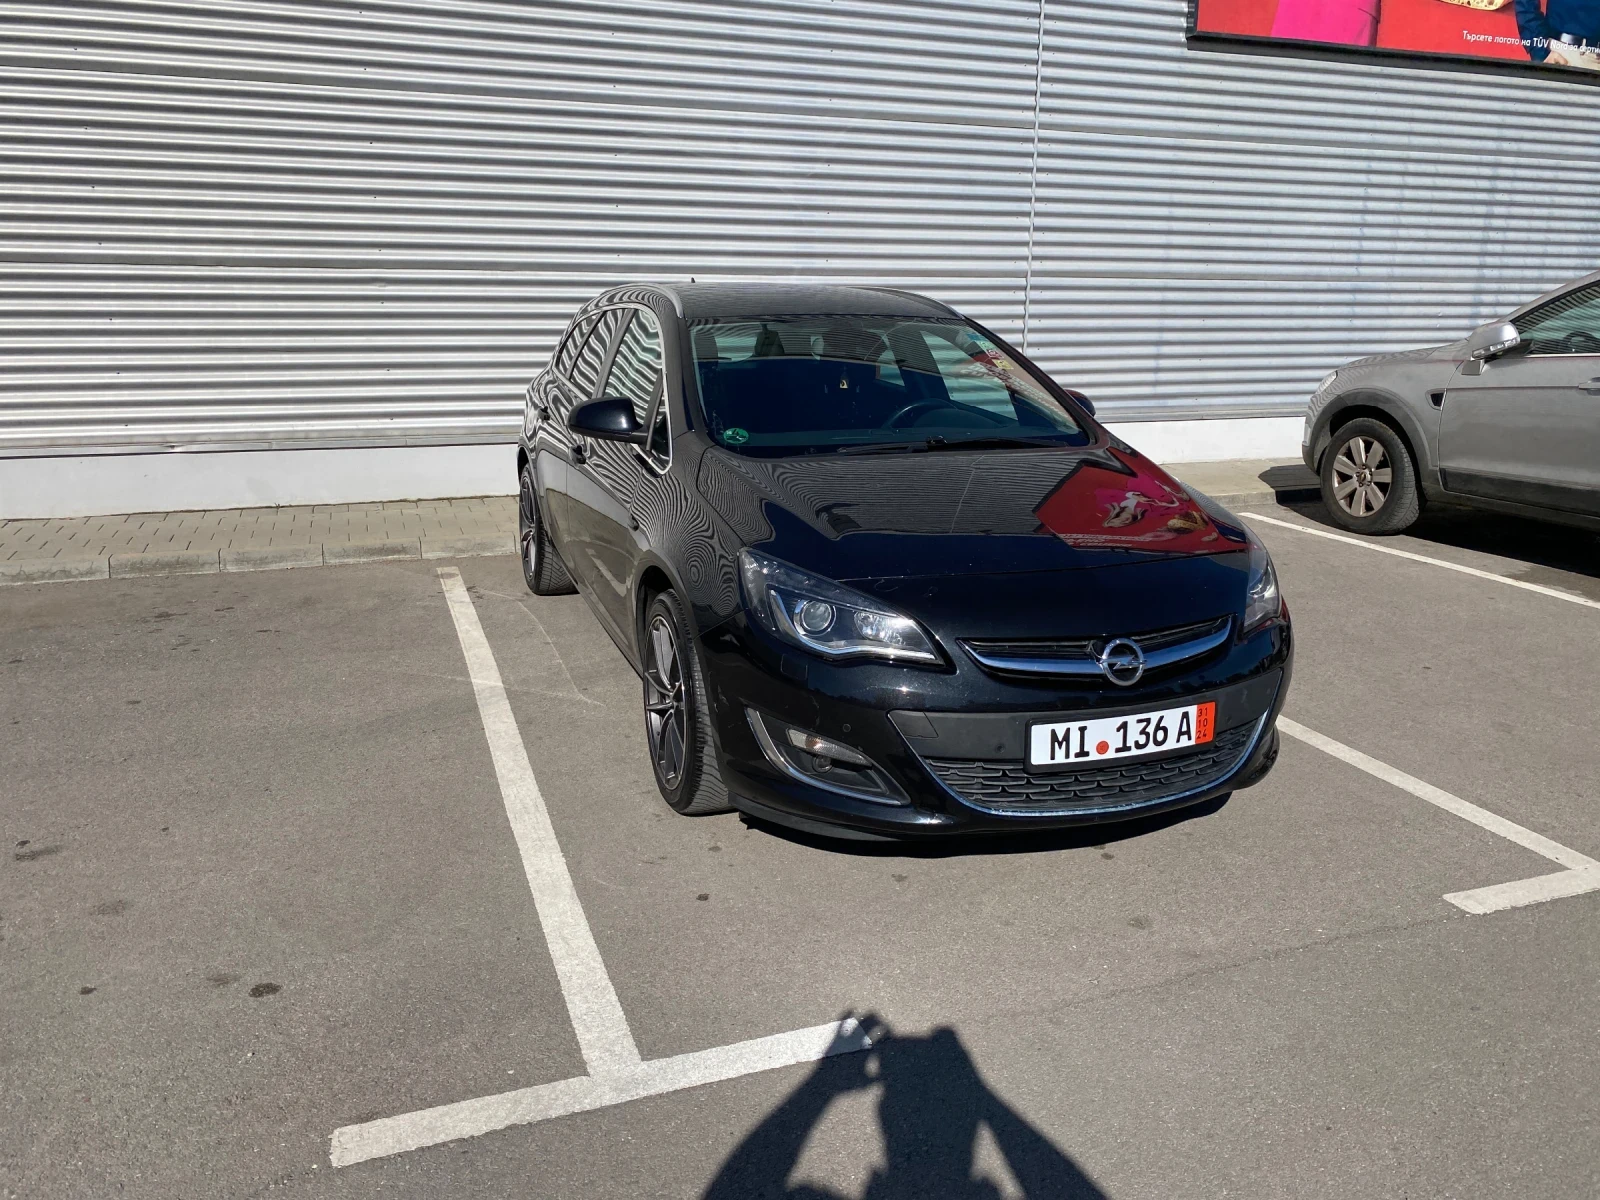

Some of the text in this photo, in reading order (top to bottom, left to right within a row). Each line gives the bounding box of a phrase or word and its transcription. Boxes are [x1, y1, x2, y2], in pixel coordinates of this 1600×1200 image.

[1462, 30, 1492, 42] Търсете
[1494, 36, 1519, 45] логото
[1521, 39, 1531, 47] на
[1533, 36, 1549, 48] TÜV
[1550, 40, 1569, 50] Nord
[1579, 45, 1600, 54] серти
[1198, 707, 1208, 717] 31
[1198, 718, 1208, 728] 10
[1049, 711, 1192, 761] MI 136 A
[1197, 728, 1207, 739] 24
